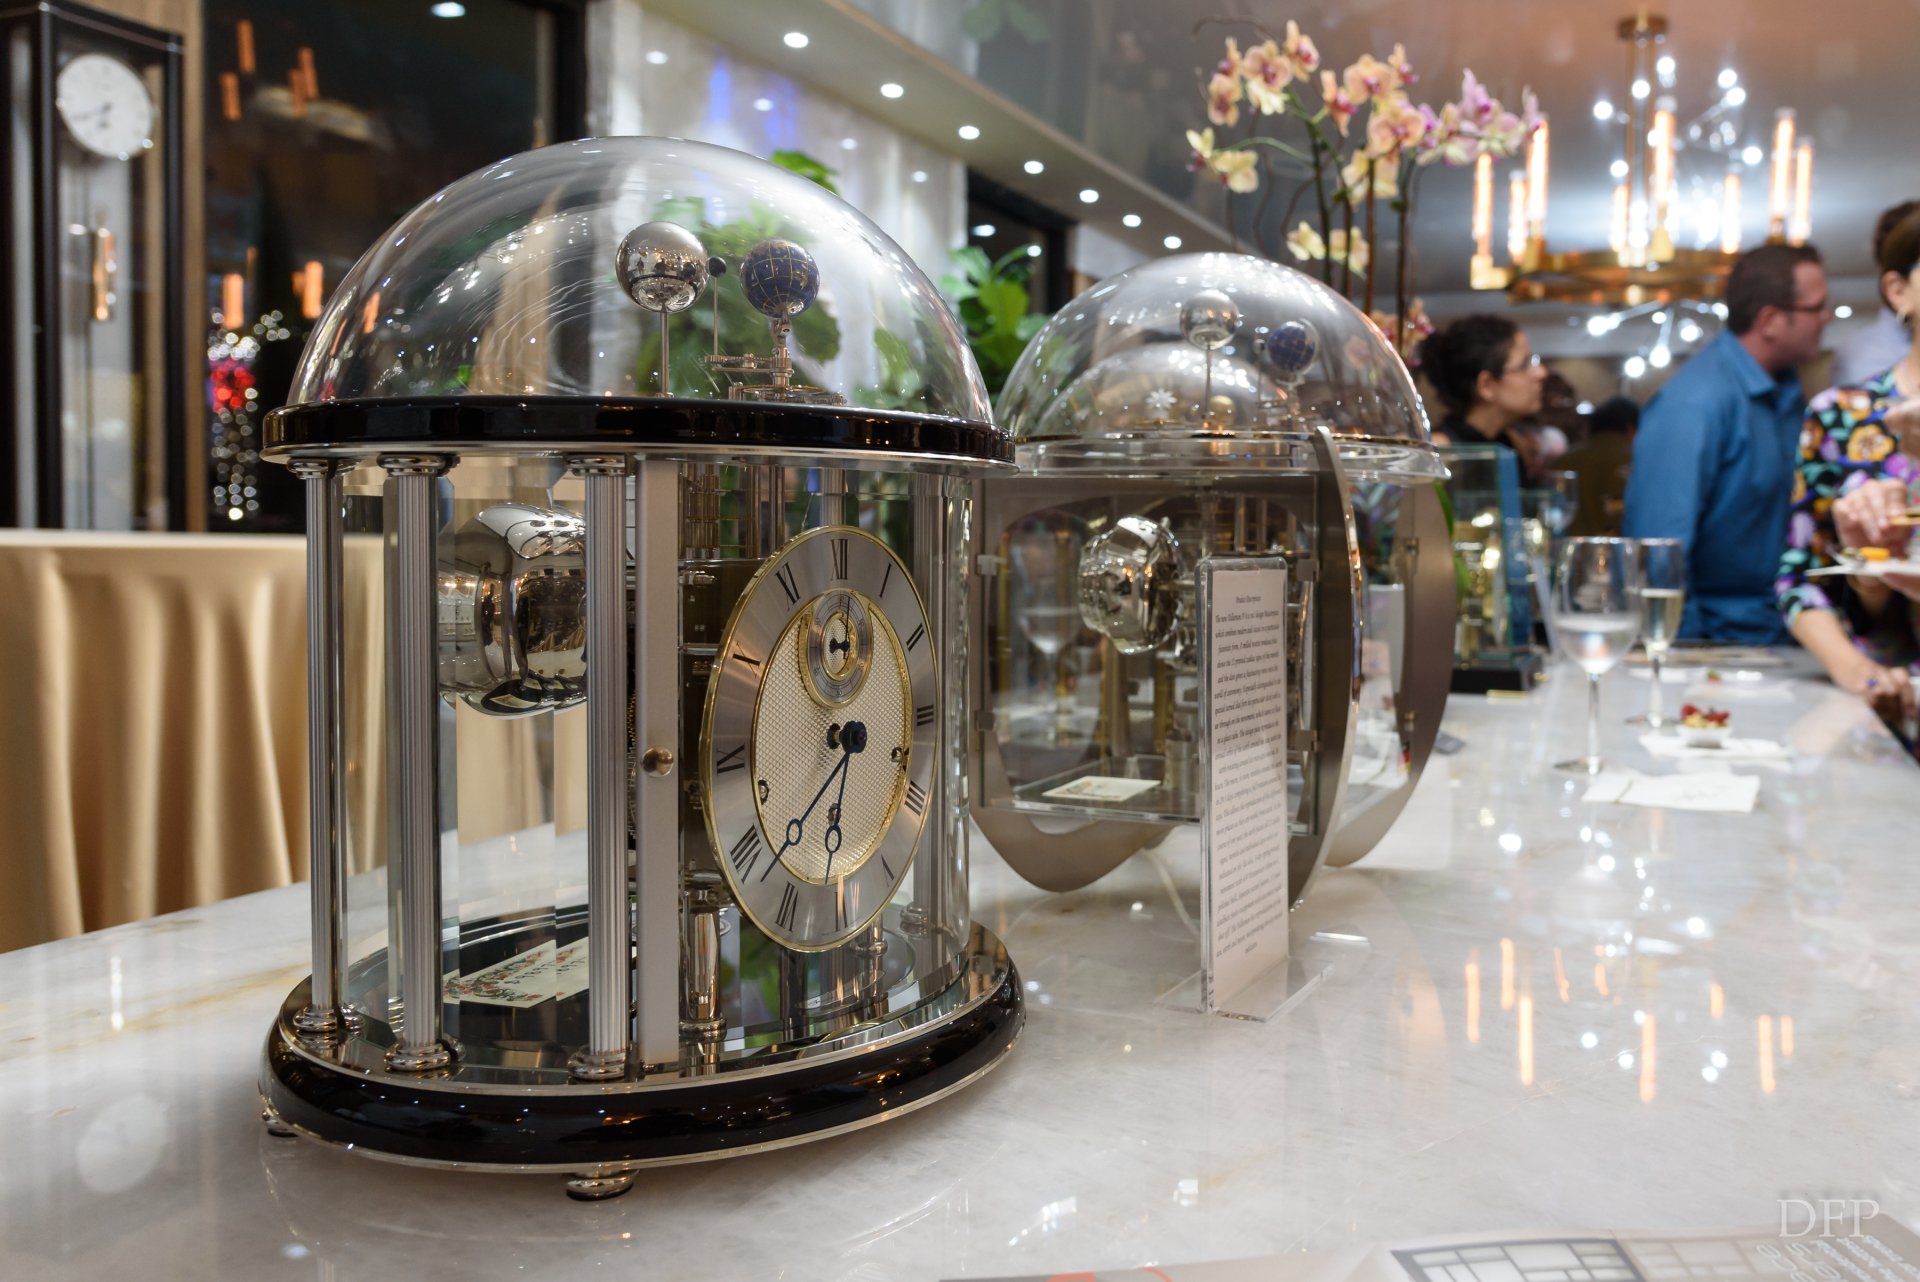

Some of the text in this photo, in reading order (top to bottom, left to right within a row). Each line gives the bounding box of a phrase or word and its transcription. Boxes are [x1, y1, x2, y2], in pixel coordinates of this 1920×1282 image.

[830, 538, 849, 581] XII
[774, 561, 801, 613] XI
[878, 562, 892, 599] I
[906, 622, 925, 652] II
[731, 640, 762, 679] X
[916, 704, 934, 727] III
[716, 742, 746, 777] IX
[904, 779, 927, 818] IIII
[729, 822, 763, 886] VIII
[774, 879, 800, 933] VII
